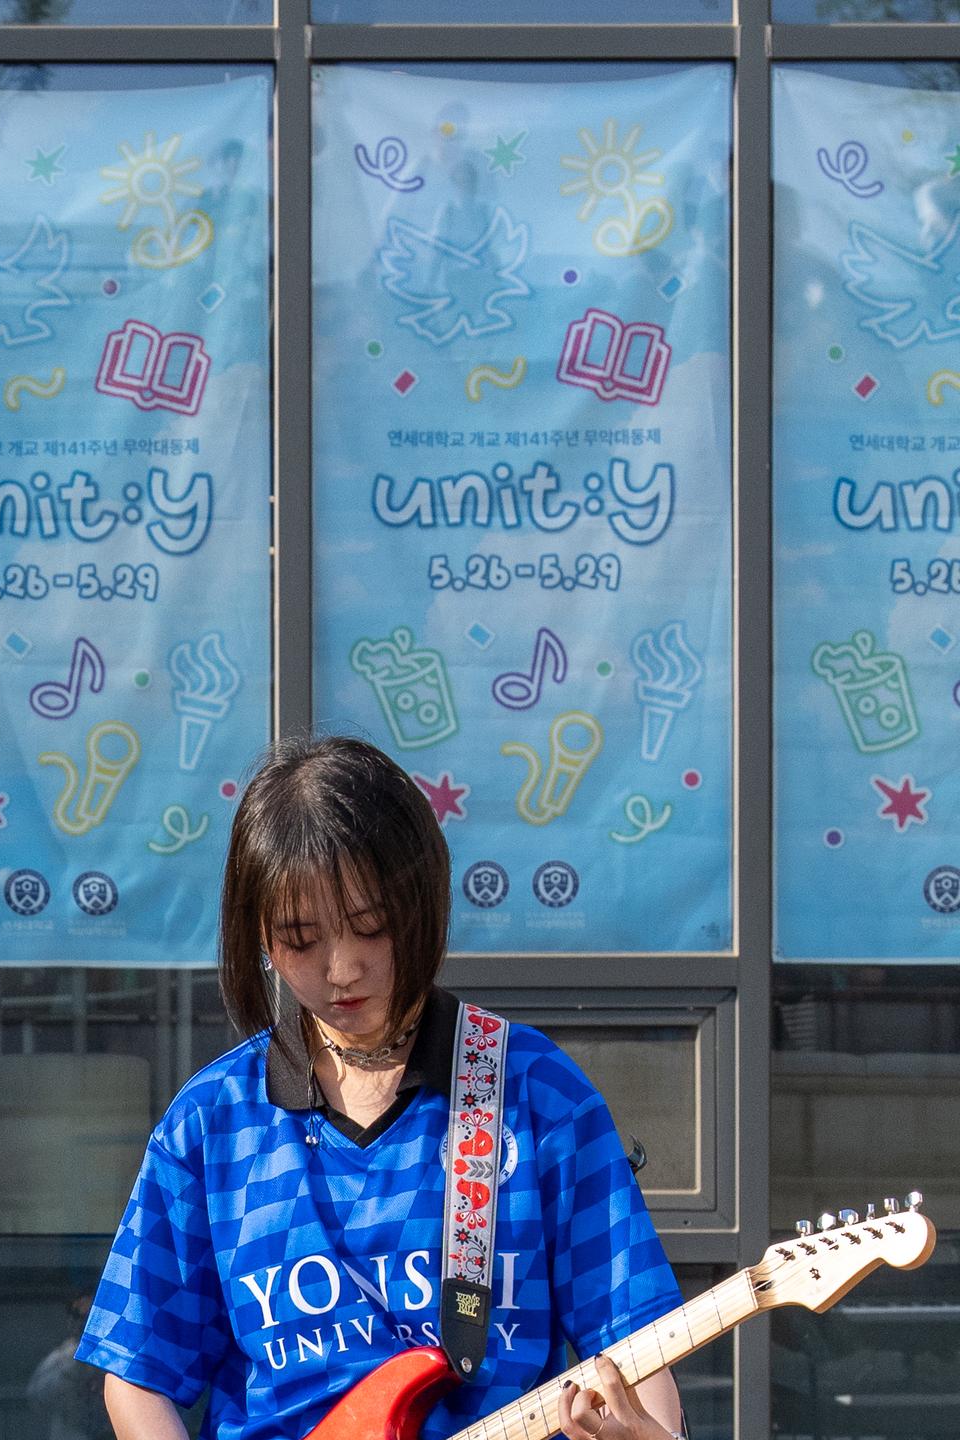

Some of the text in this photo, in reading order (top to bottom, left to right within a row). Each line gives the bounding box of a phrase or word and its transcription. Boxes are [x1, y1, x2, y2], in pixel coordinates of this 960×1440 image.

[8, 439, 39, 456] 개교
[43, 439, 118, 456] 제141주년
[123, 437, 200, 456] 무악대동제
[387, 428, 662, 447] 연세대학교 개교 제141주년 무악대동제
[849, 434, 925, 451] 연세대학교
[372, 457, 676, 546] unit:y
[239, 1250, 521, 1330] YONSI
[262, 1315, 521, 1371] UNIVRSY
